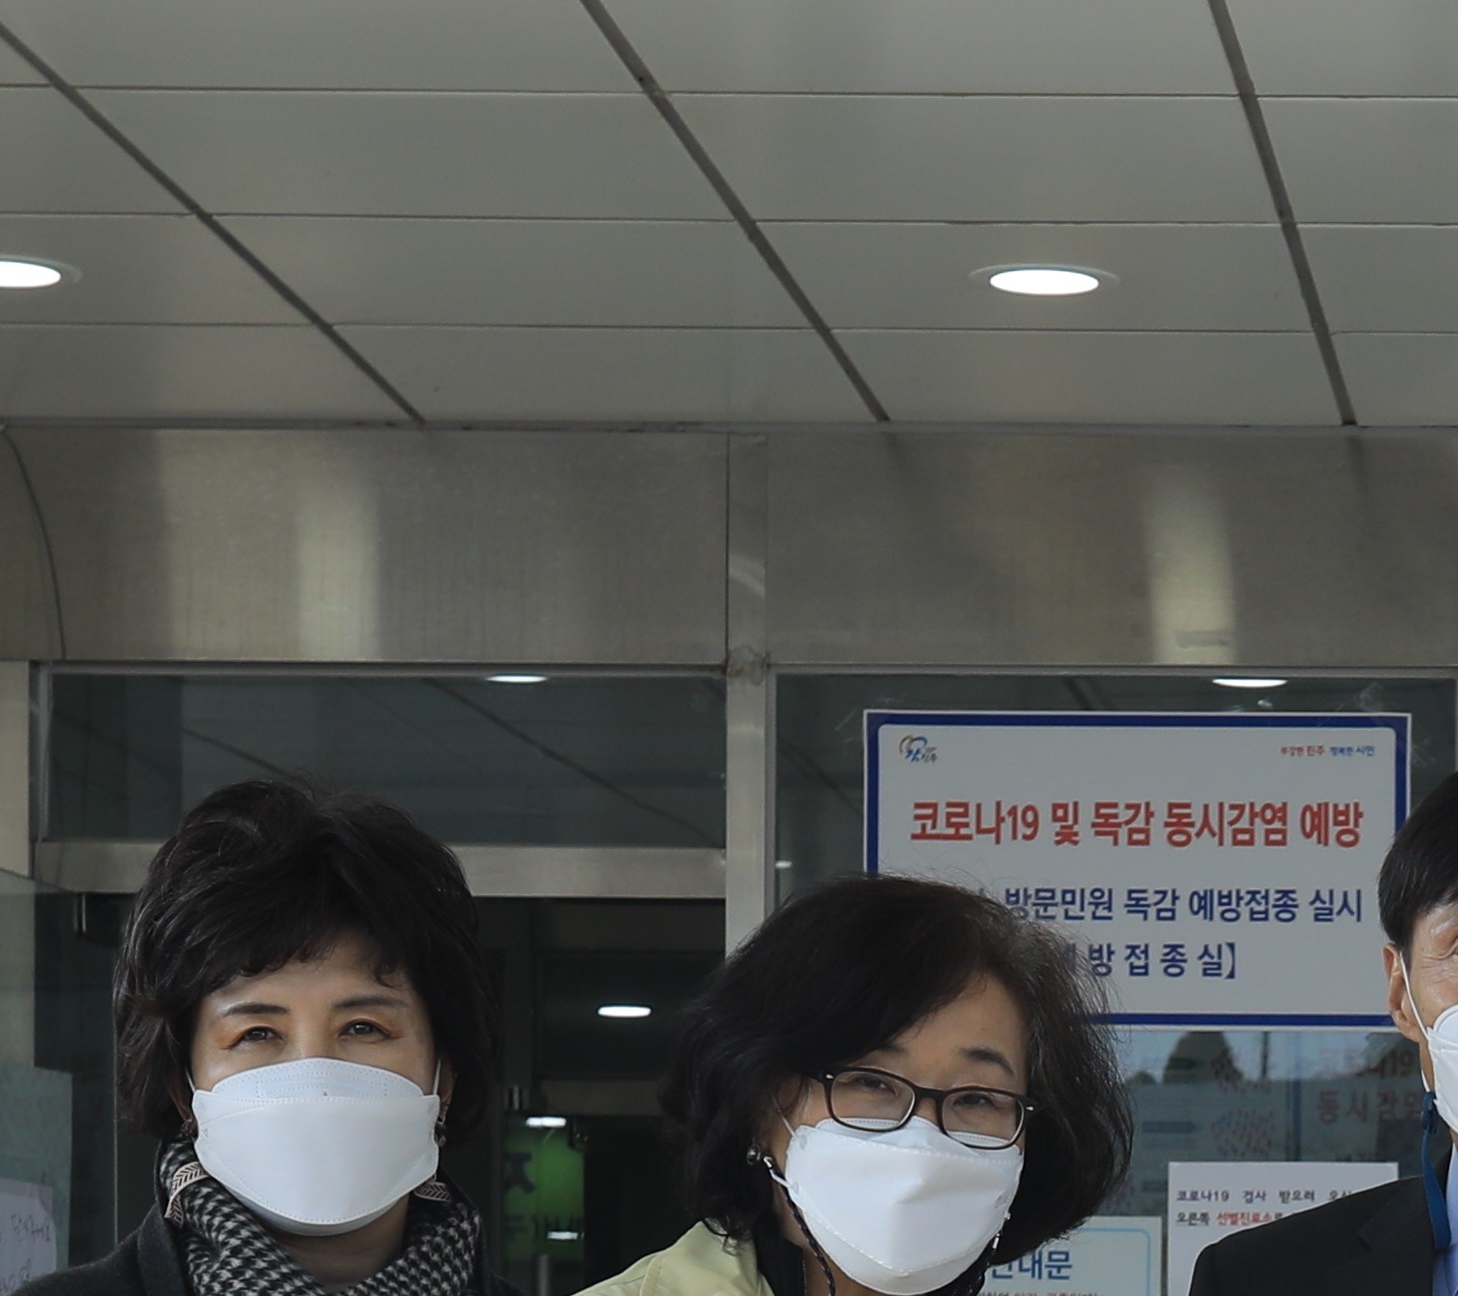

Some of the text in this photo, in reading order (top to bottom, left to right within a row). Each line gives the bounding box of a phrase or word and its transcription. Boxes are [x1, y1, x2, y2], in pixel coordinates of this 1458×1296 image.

[910, 801, 1364, 849] 코로나19 및 독감 동시감염 예방
[1004, 887, 1363, 923] 방문민원 독감 예방접종 실시
[1177, 1190, 1230, 1202] 코로나19
